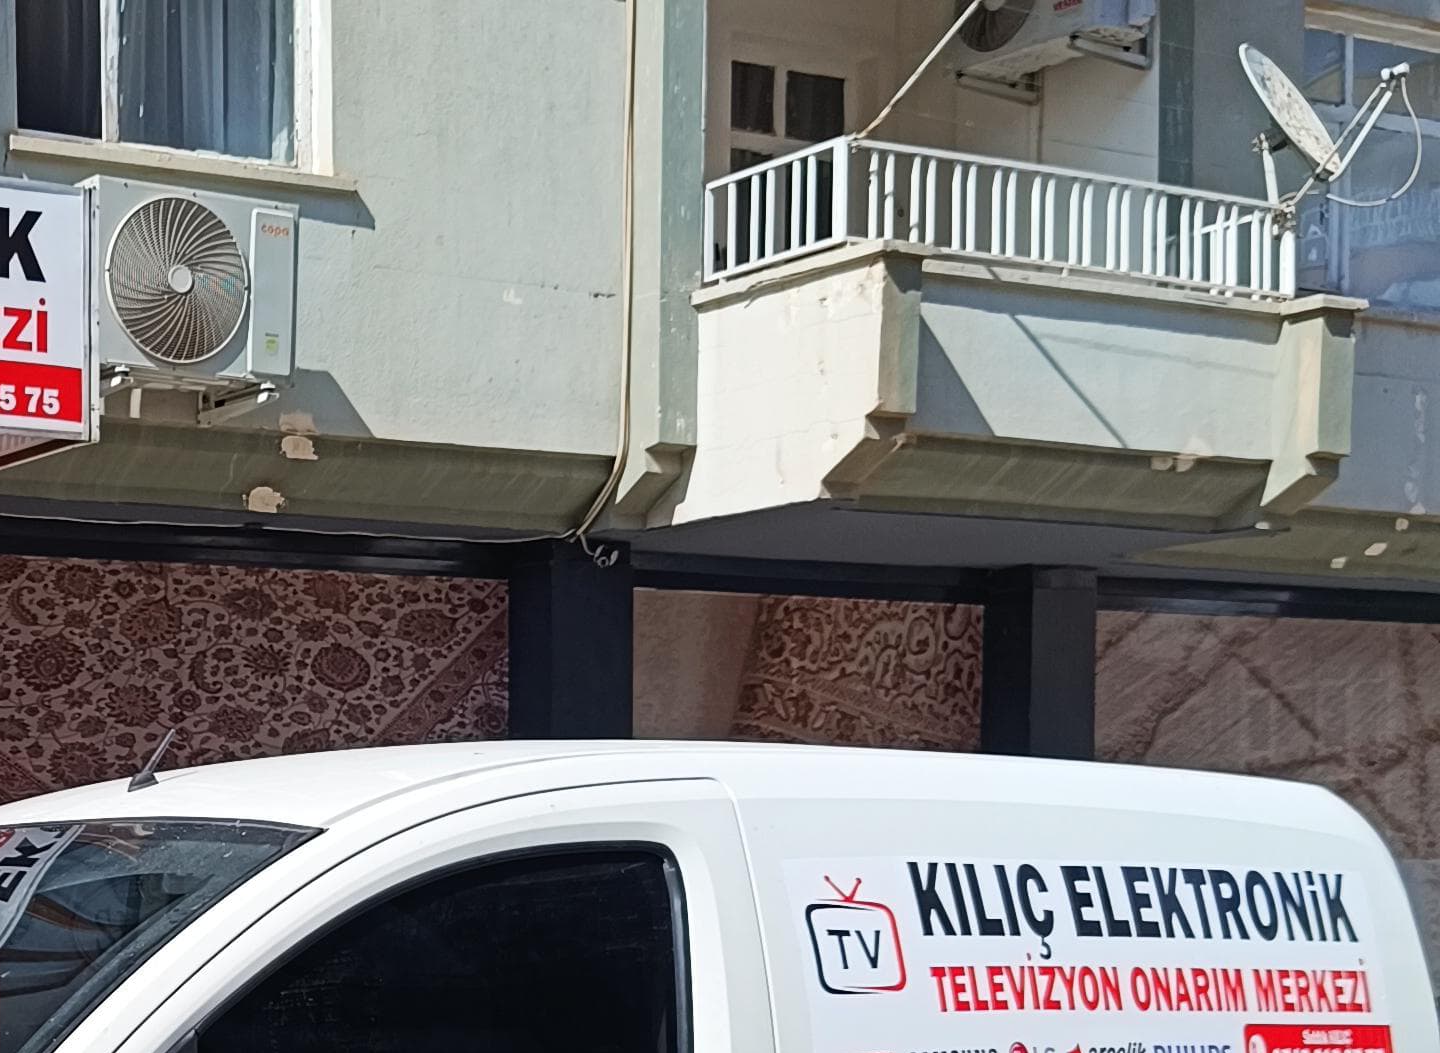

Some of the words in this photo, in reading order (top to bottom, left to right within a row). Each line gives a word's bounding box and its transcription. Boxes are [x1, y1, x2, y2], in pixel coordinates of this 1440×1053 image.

[24, 388, 60, 415] 75
[906, 861, 1054, 960] KILIÇ
[827, 929, 882, 971] TV
[929, 952, 1122, 1013] TELEVİZYON
[1129, 966, 1248, 1013] ONARIM
[1252, 957, 1373, 1013] MERKEZİ
